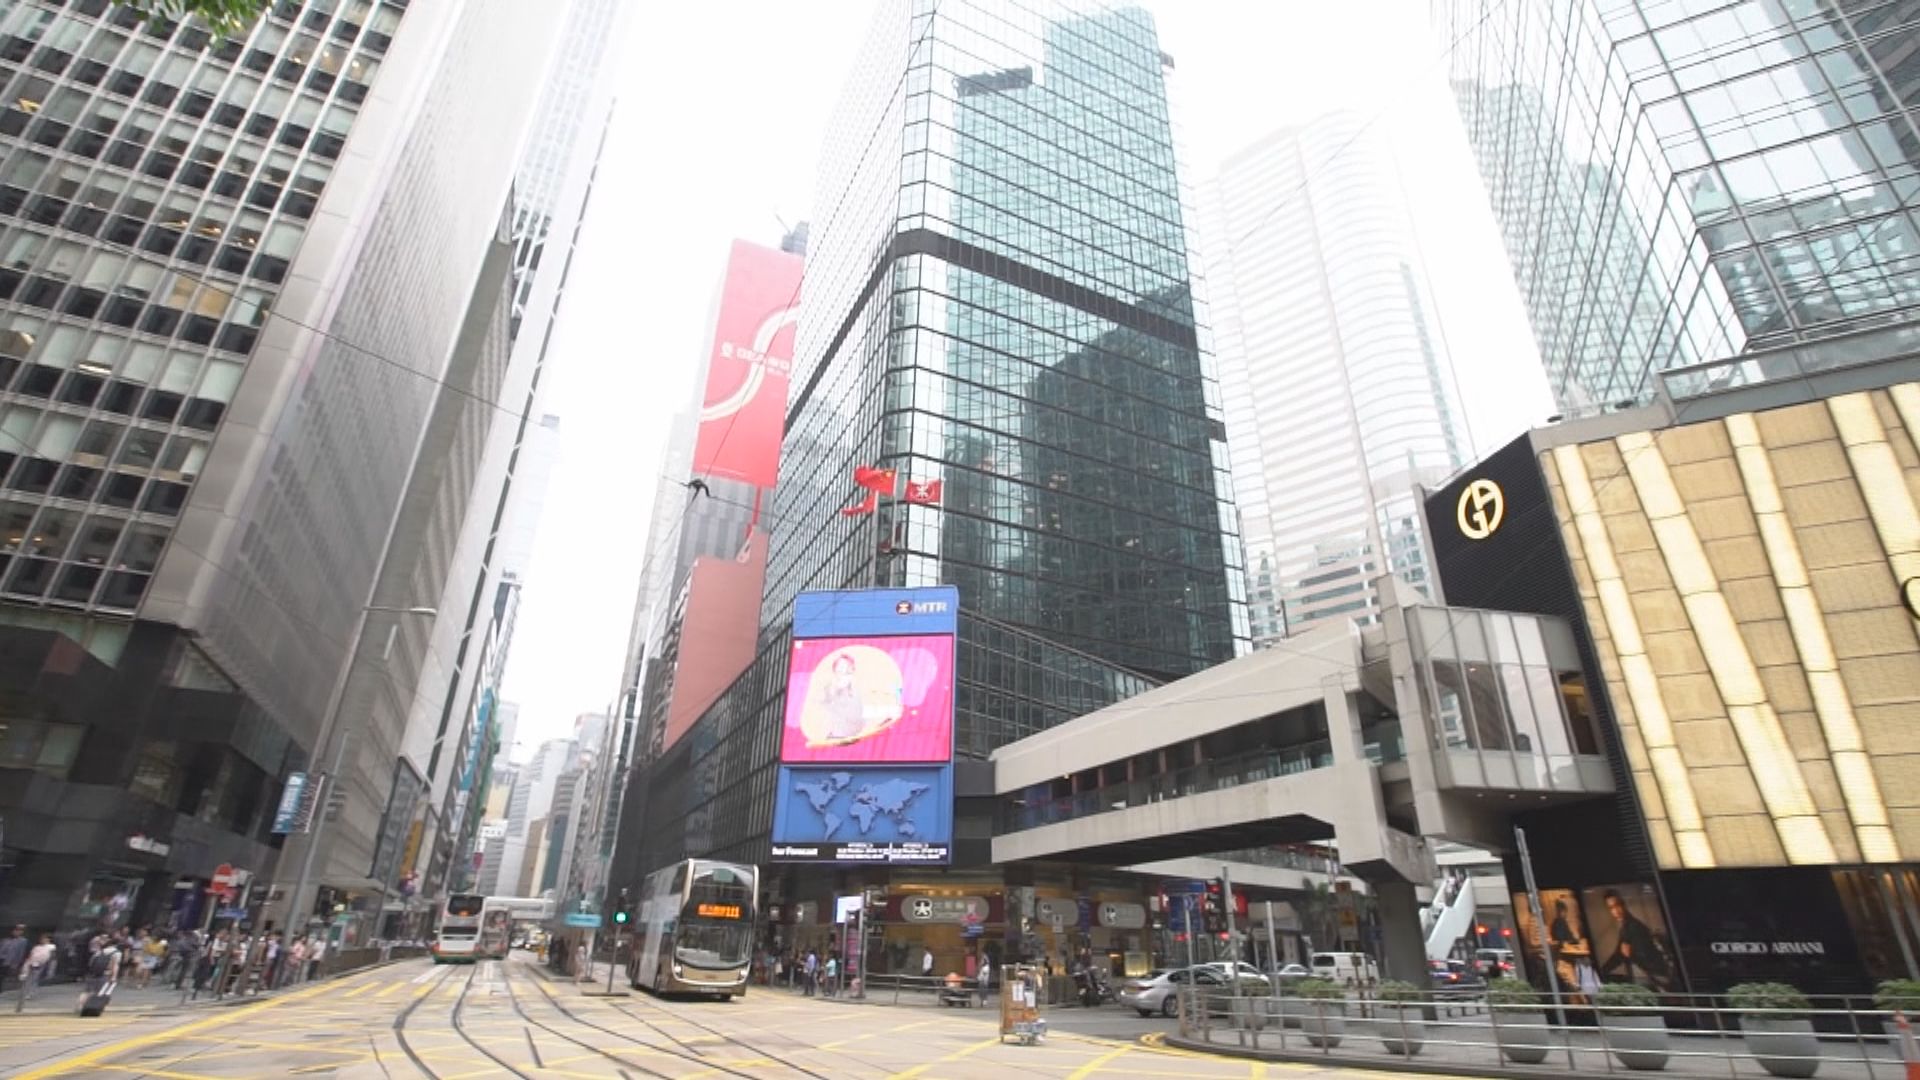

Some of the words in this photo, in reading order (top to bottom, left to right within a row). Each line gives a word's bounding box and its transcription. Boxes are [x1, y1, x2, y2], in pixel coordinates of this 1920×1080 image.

[914, 602, 947, 614] MTR
[1711, 942, 1768, 953] GIORGIO
[1772, 942, 1824, 954] ARMANI
